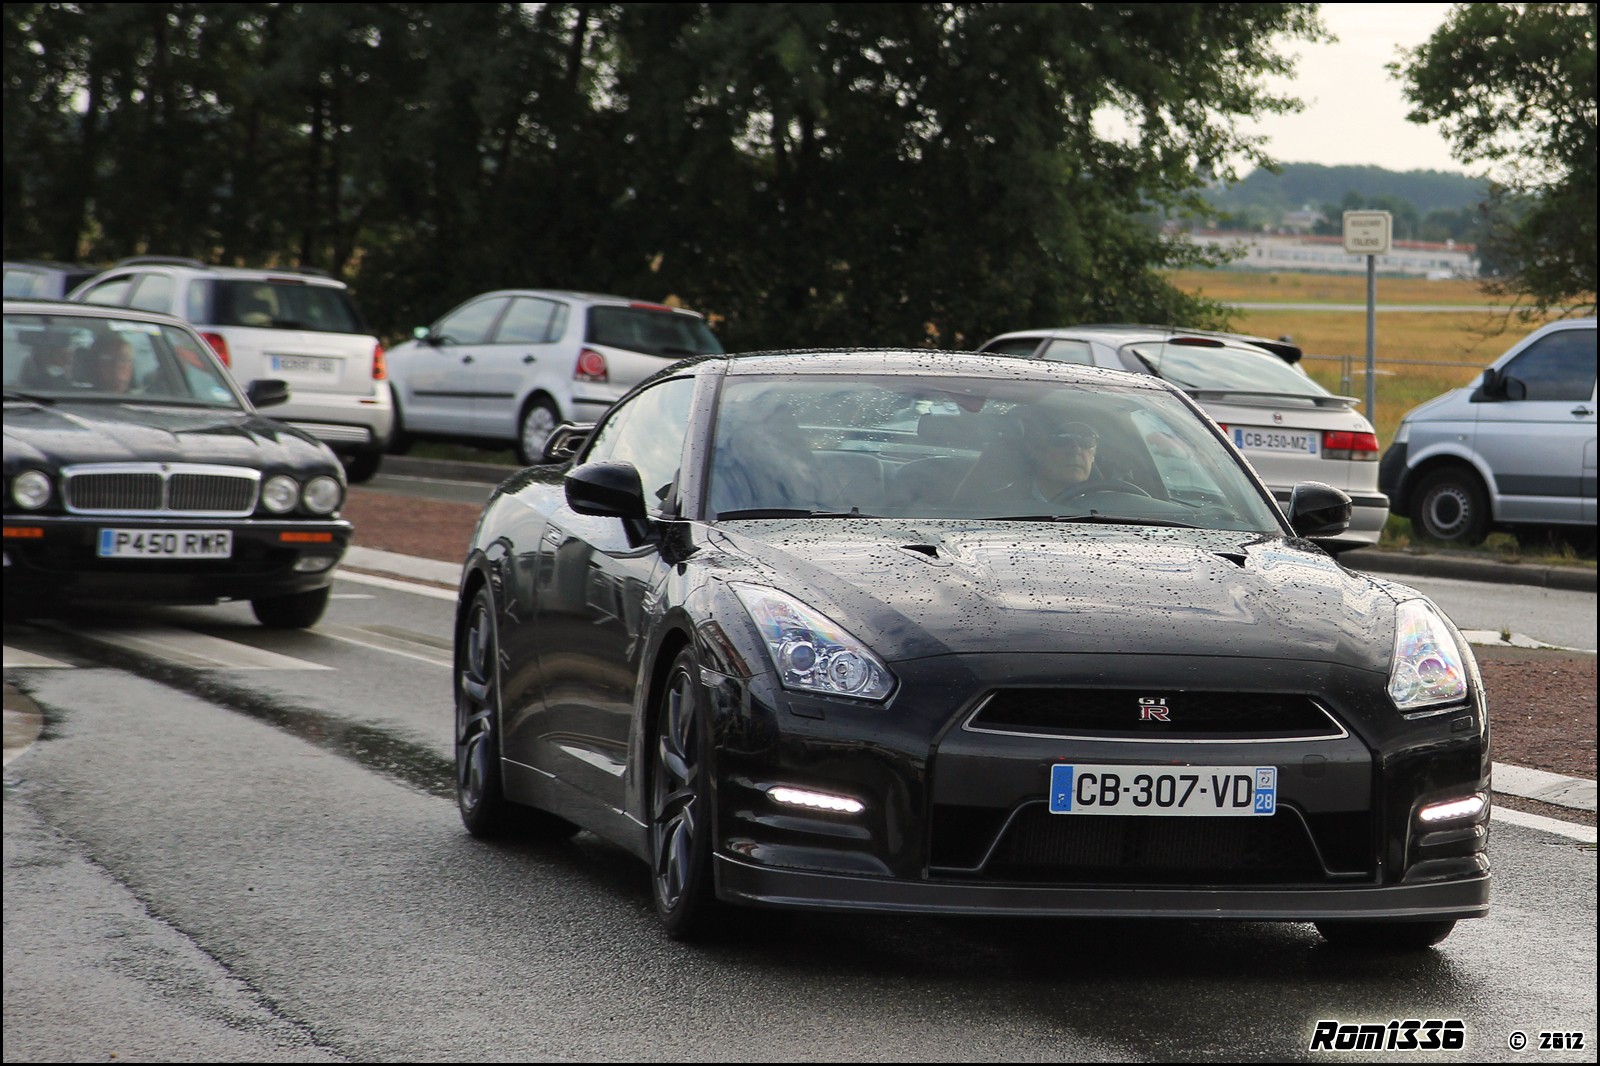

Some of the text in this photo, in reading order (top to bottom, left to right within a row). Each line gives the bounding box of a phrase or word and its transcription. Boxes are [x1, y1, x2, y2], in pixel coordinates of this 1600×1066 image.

[1244, 432, 1307, 450] CB-250-MZ
[116, 533, 228, 554] P450 RWR
[1076, 772, 1253, 808] CB-307-VD
[1255, 793, 1273, 810] 28
